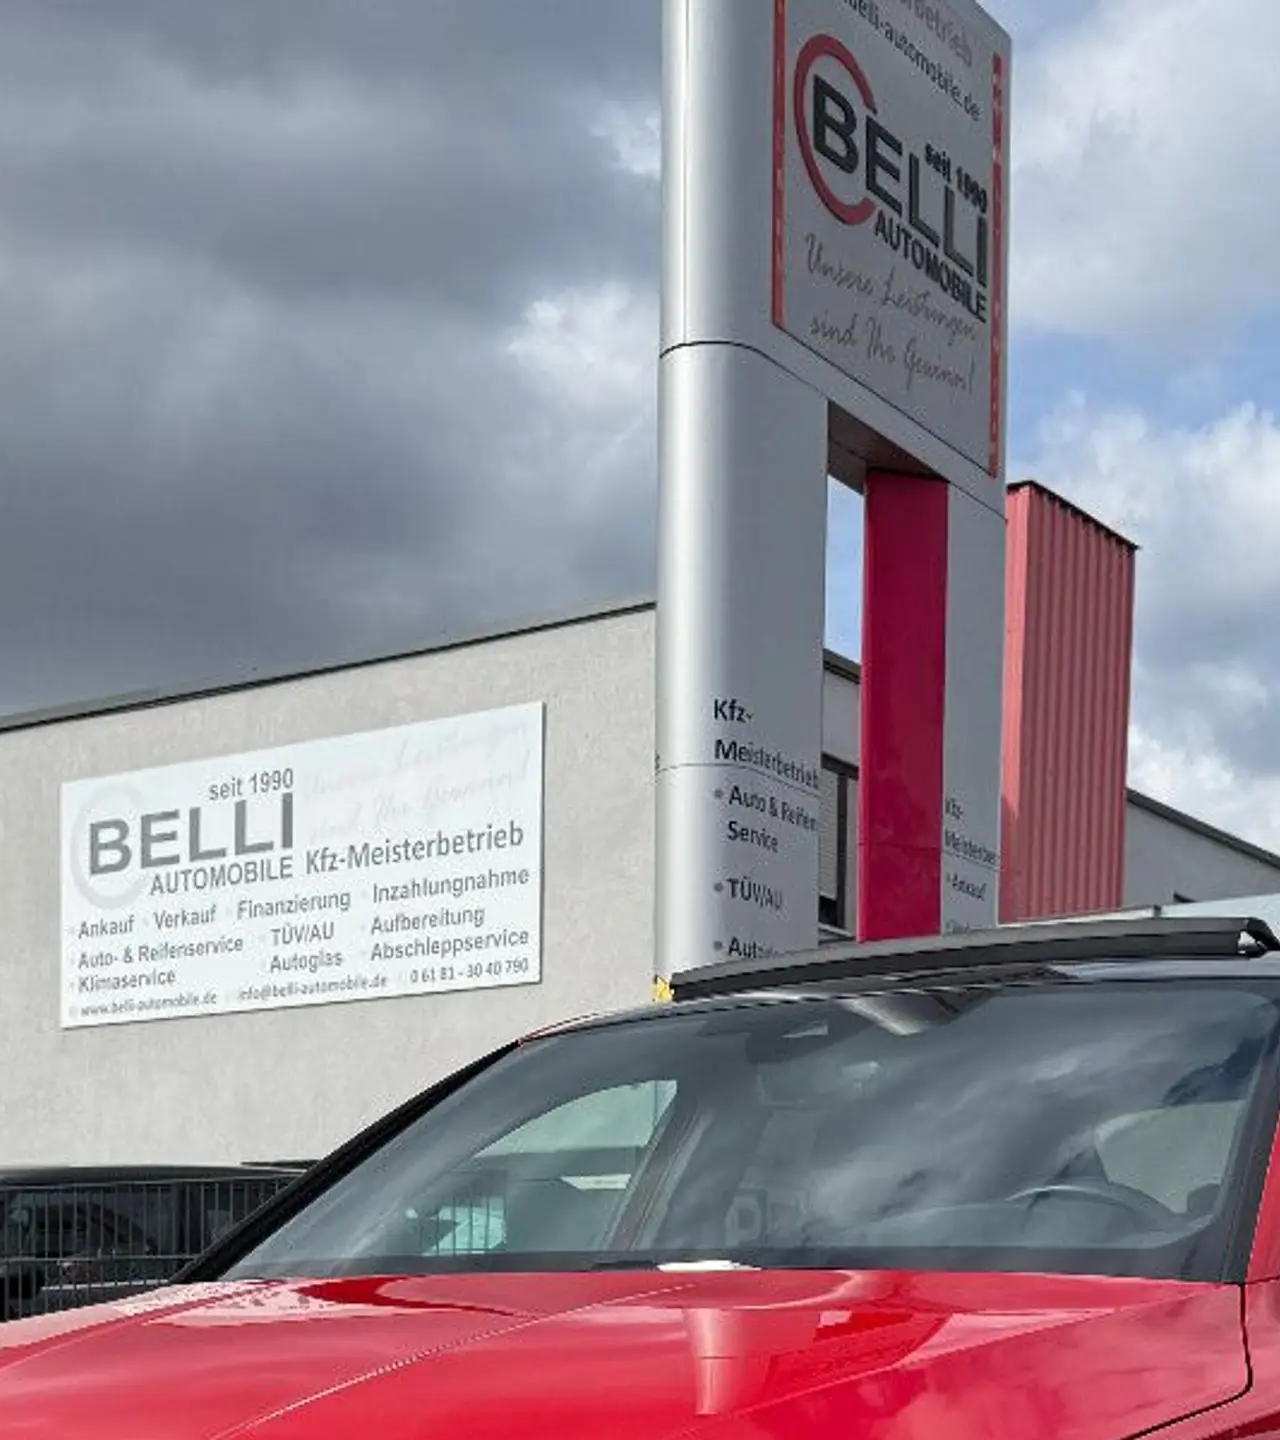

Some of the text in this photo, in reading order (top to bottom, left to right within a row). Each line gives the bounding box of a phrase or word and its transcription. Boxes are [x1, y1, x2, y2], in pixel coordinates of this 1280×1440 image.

[813, 74, 988, 288] BELLI
[924, 143, 987, 215] seit 1990
[874, 209, 987, 324] AUTOMOBILE
[713, 698, 753, 724] Kfz-
[209, 767, 294, 802] seit 1990
[714, 738, 819, 790] Meisterbetrieb
[89, 791, 294, 876] BELLI
[305, 818, 525, 876] Kfz-Meisterbetrieb
[727, 820, 779, 854] Service
[77, 867, 530, 940] Ankauf Verkauf Finanzierung Inzahlungnahme
[149, 855, 294, 897] AUTOMOBILE
[77, 905, 486, 971] Auto- & Reifenservice TÜV/AU Aufbereitung
[77, 929, 530, 994] Klimaservice Autoglas Abschleppservice
